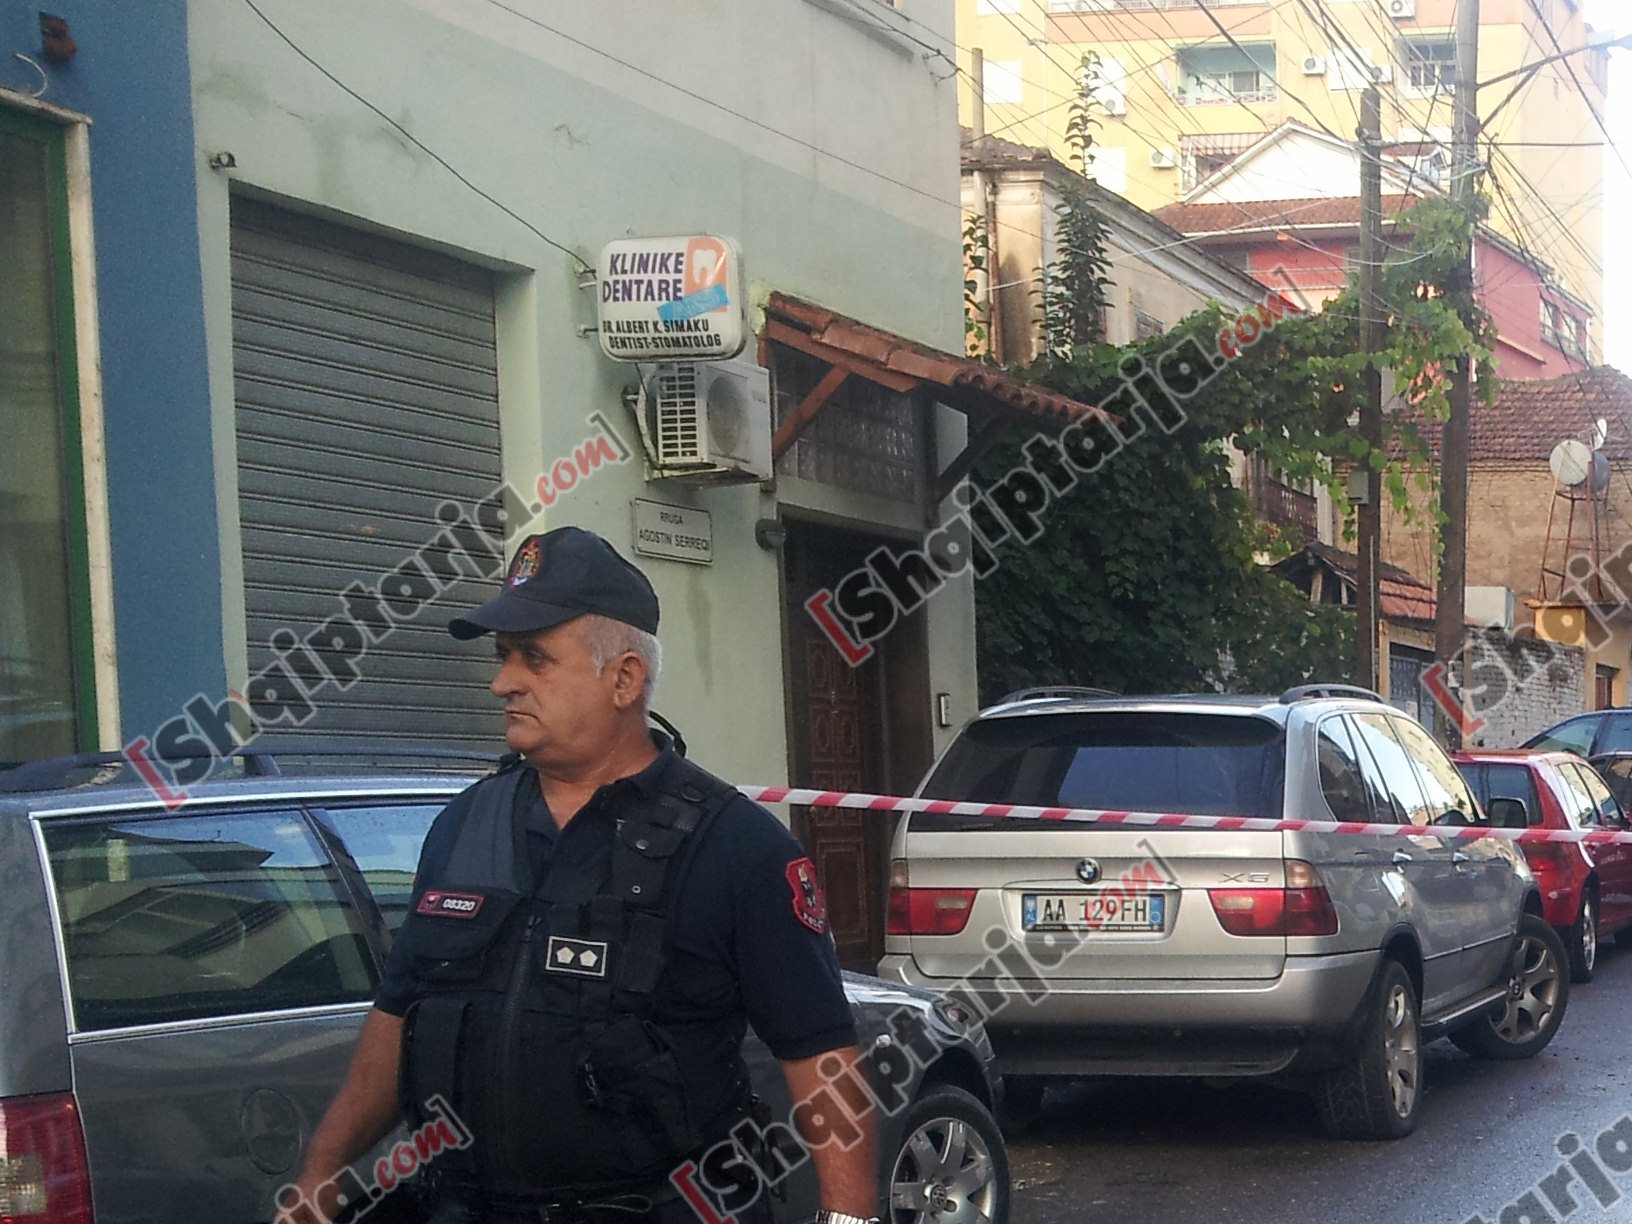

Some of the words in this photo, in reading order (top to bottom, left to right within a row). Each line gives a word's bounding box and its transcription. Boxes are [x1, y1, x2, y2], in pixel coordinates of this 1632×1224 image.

[609, 252, 685, 276] KLINIKE
[602, 279, 683, 303] DENTARE
[616, 320, 650, 334] ALBERT
[663, 318, 710, 333] SIMAKU
[1042, 898, 1066, 922] AA
